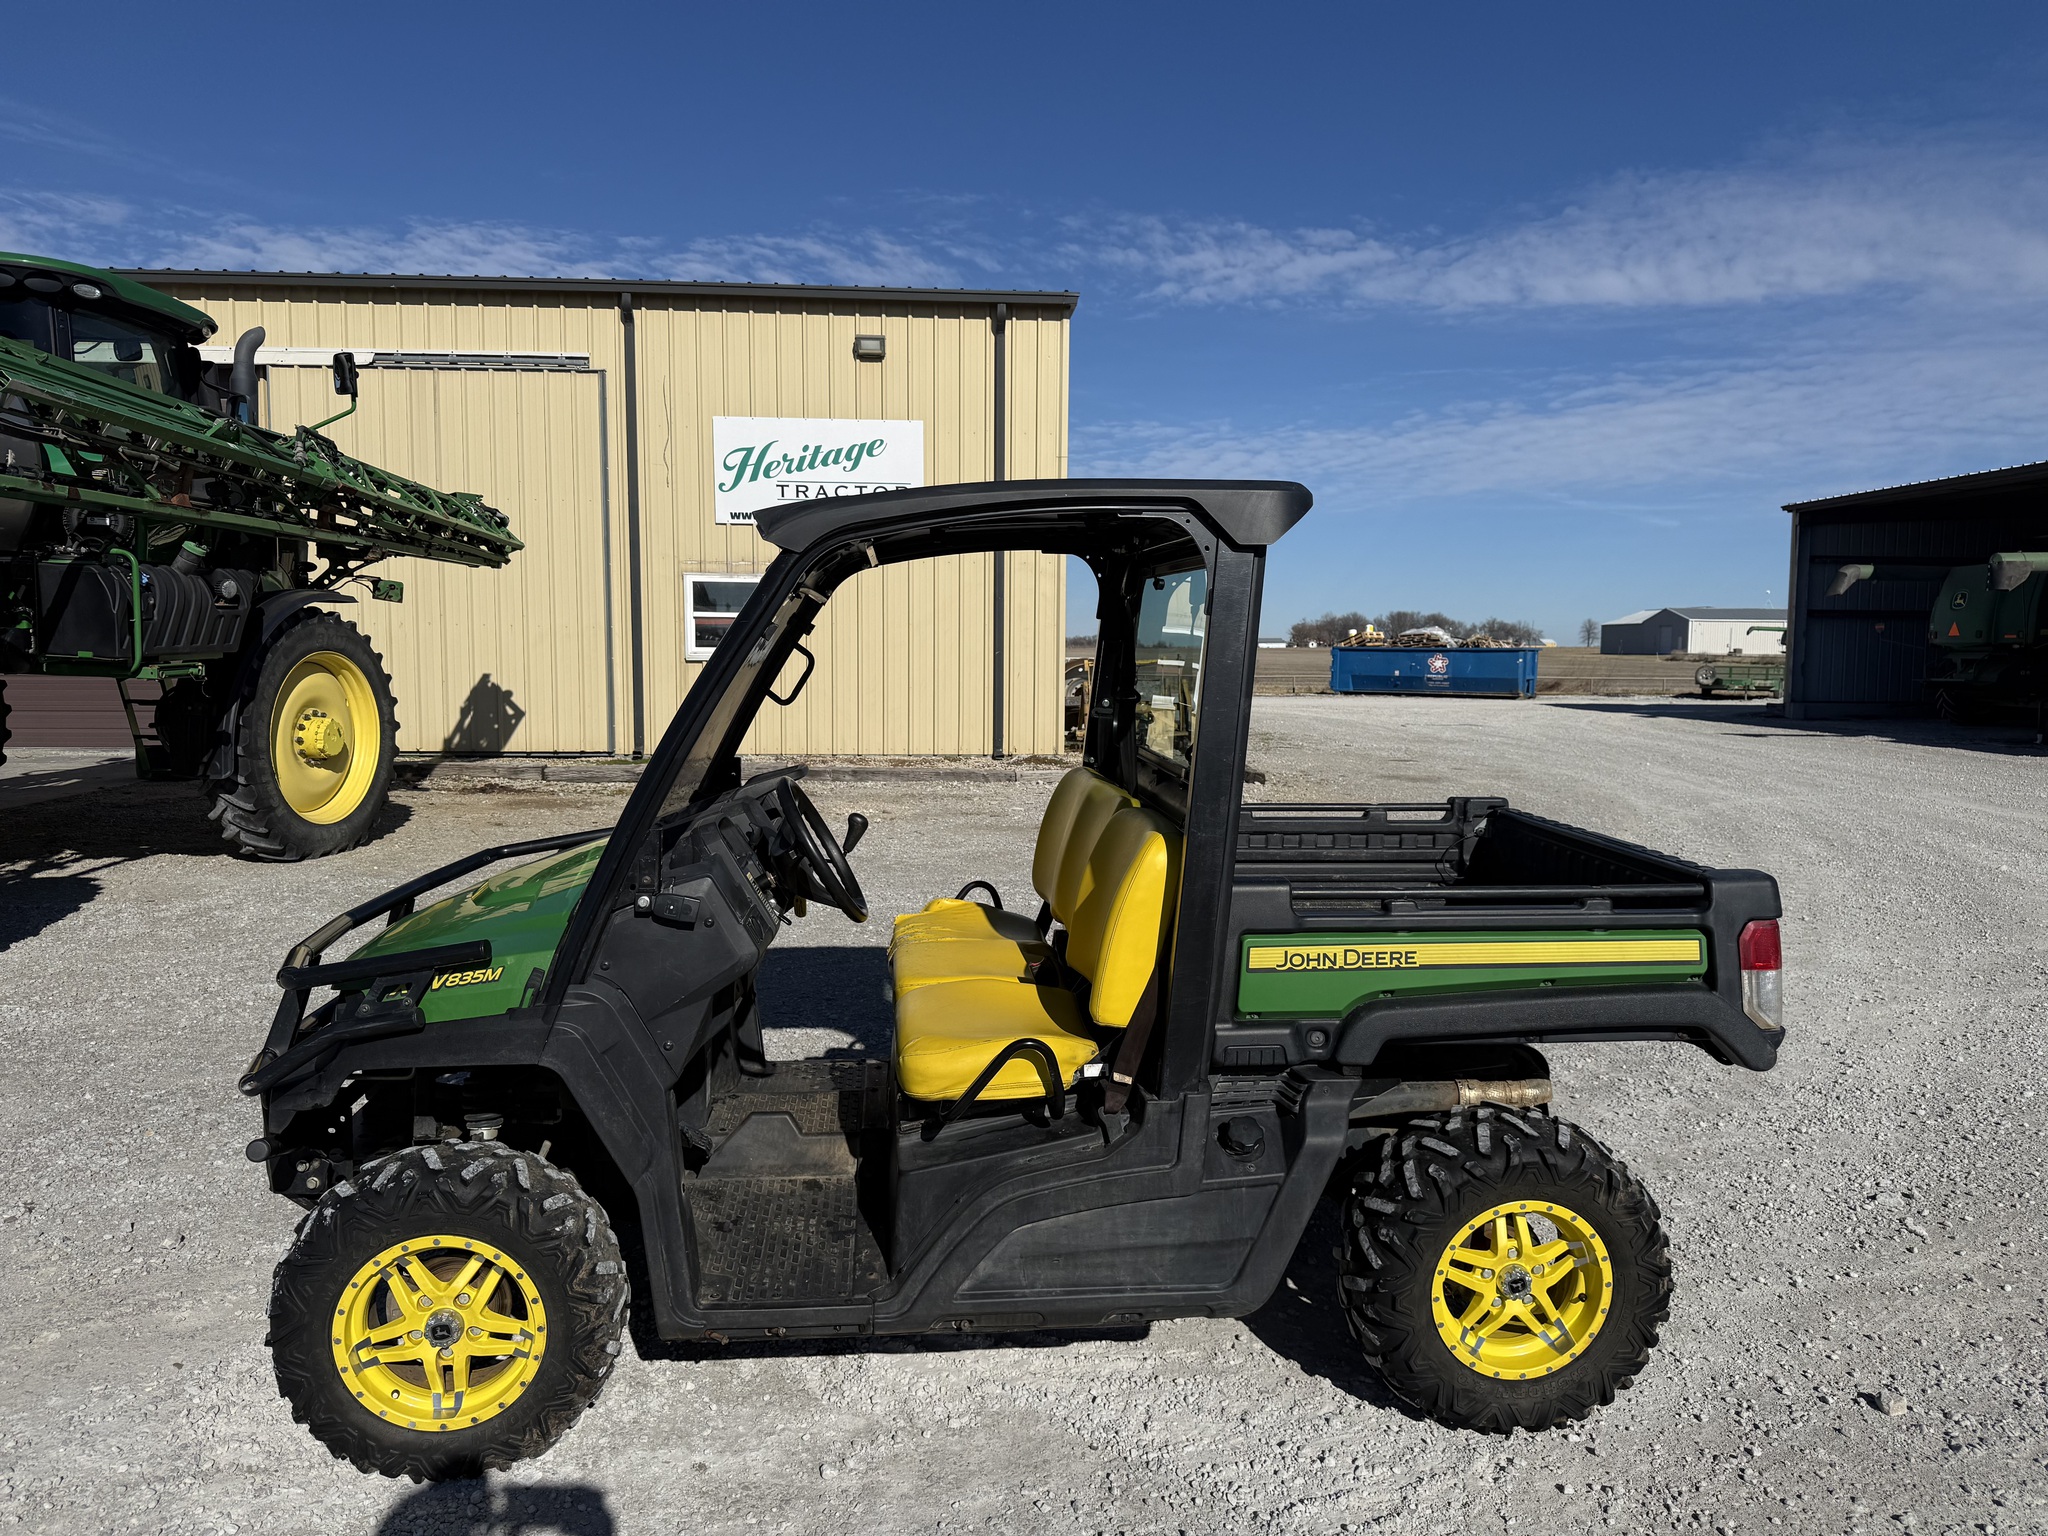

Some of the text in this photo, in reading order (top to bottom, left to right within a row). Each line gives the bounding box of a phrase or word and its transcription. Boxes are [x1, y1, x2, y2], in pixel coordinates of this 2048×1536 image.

[718, 438, 888, 493] Heritage
[775, 484, 908, 498] TRACT
[1275, 948, 1418, 968] JOHN DEERE
